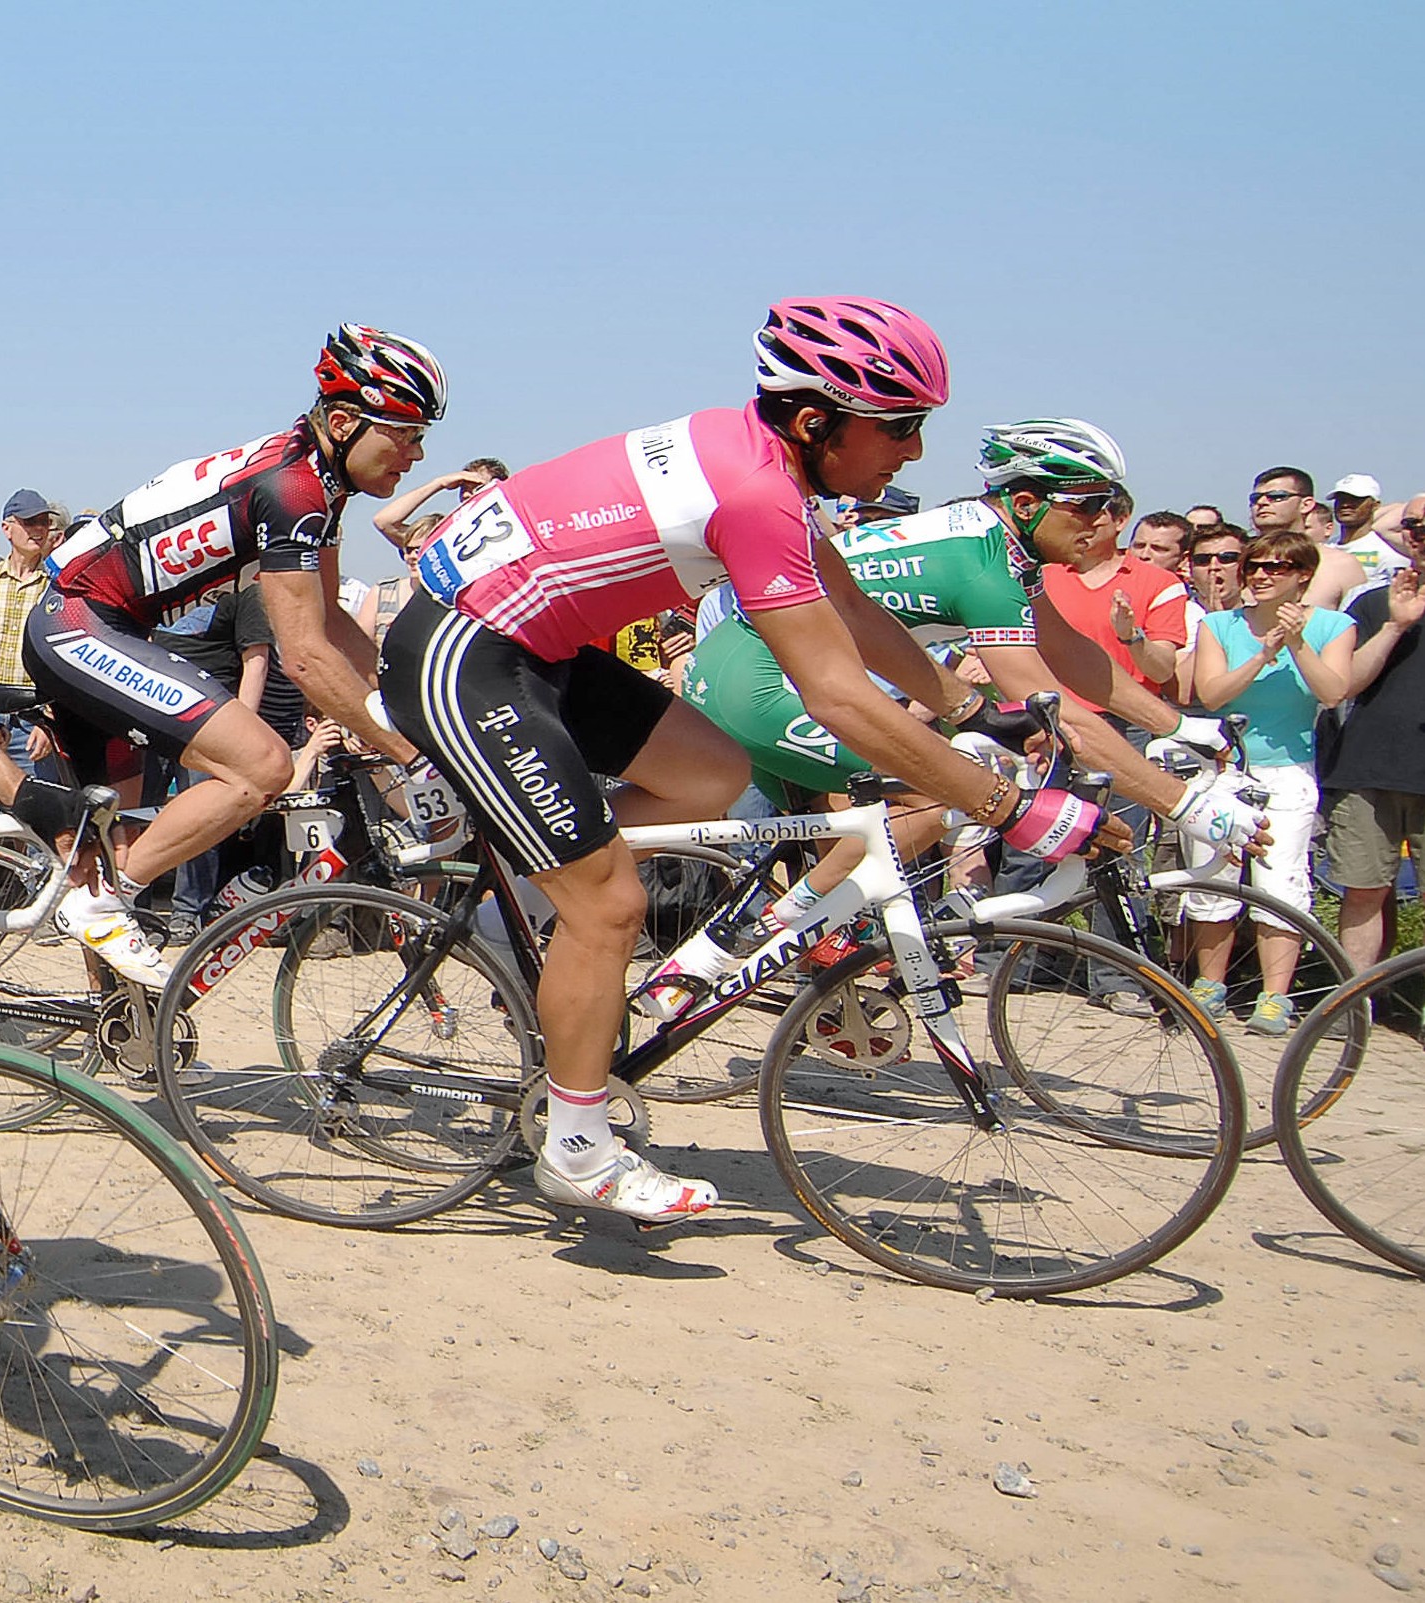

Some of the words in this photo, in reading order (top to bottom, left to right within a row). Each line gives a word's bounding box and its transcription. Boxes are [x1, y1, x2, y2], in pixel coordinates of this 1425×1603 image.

[453, 501, 514, 562] 53
[848, 552, 925, 583] RÉDIT
[763, 583, 798, 596] adidas
[869, 590, 941, 616] COLE
[70, 642, 184, 708] ALM.BRAND
[413, 787, 451, 821] 53
[307, 825, 320, 849] 6
[883, 816, 908, 882] GIANT
[714, 915, 829, 1002] GIANT
[410, 1083, 484, 1104] SHIMANO
